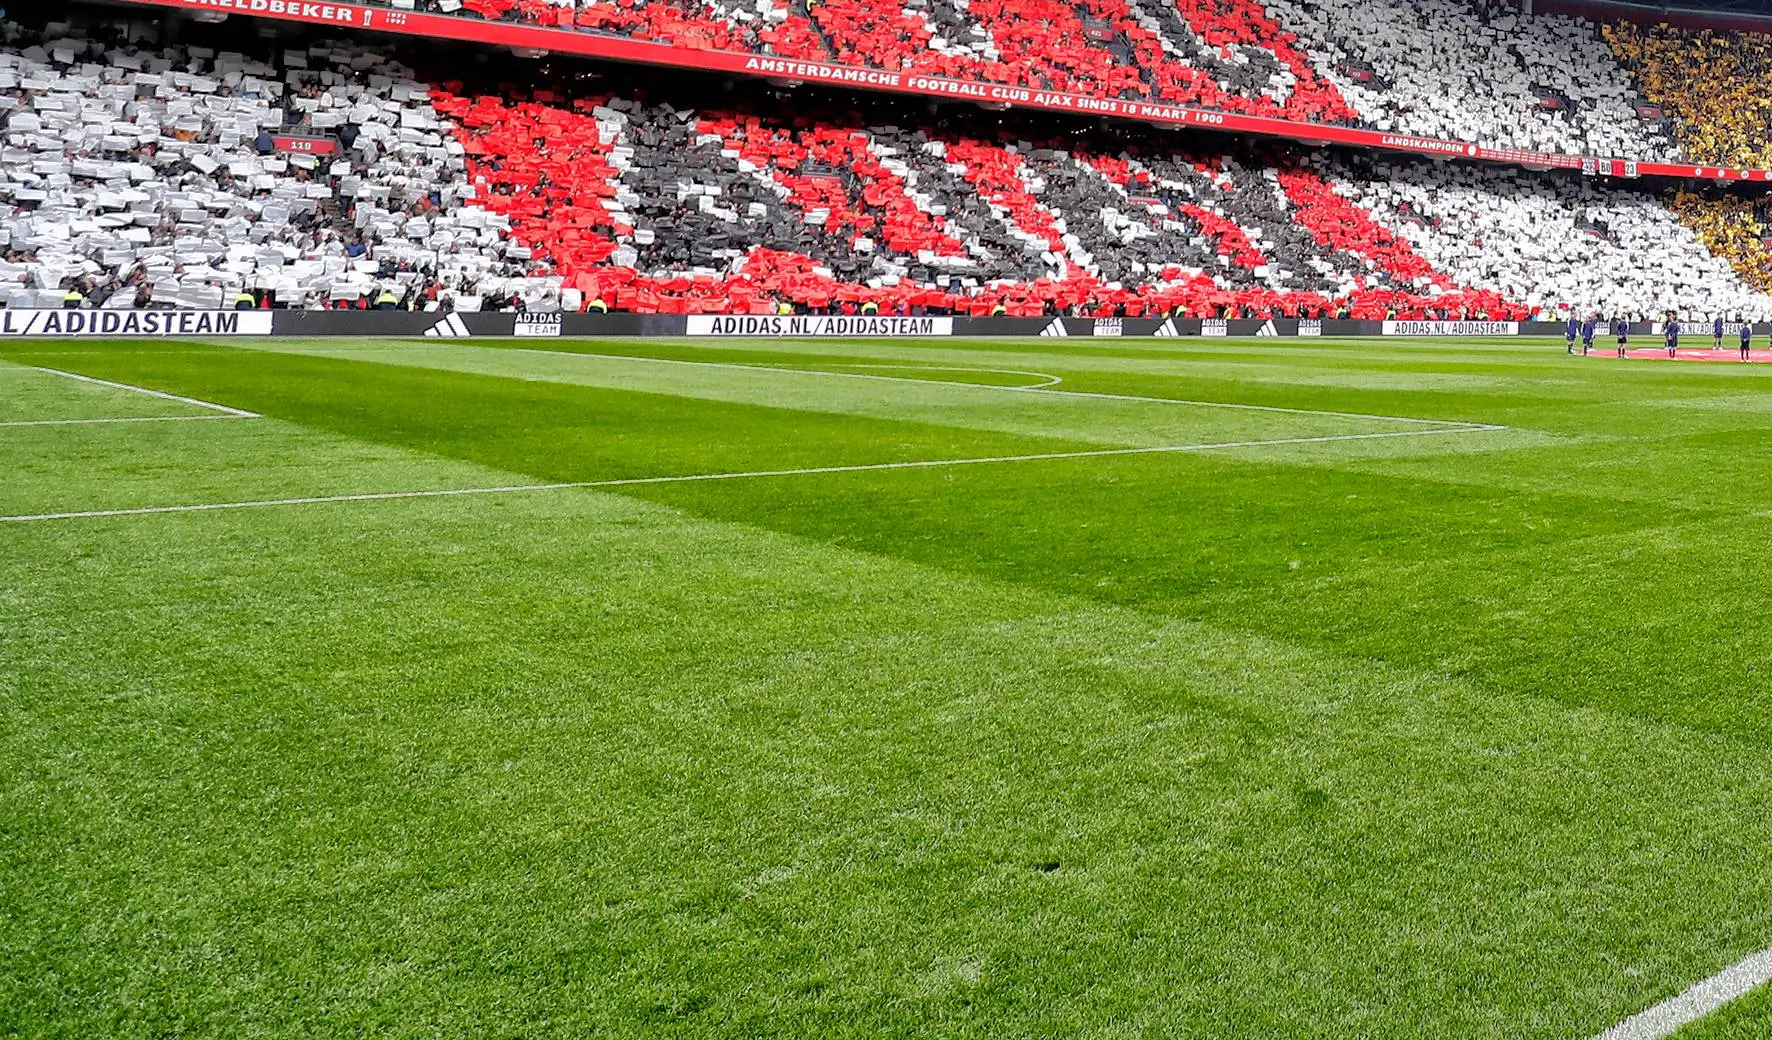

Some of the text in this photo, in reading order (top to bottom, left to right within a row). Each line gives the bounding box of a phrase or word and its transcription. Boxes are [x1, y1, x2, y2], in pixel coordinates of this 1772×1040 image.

[745, 58, 900, 86] AMSTERDAMSCHE
[907, 78, 987, 96] FOOTBALL
[991, 87, 1030, 101] CLUB
[1033, 93, 1073, 107] AJAX
[1077, 98, 1117, 112] SINDS
[1121, 103, 1136, 114] 18
[1141, 106, 1188, 120] MAART
[1194, 112, 1224, 124] 1900
[1381, 135, 1464, 153] LANDSKAMPIOEN
[515, 313, 562, 323] ADIDAS
[1094, 318, 1122, 326] ADIDAS
[1201, 319, 1227, 327] ADIDAS
[527, 325, 558, 334] TEAM
[711, 317, 933, 335] ADIDAS.NL/ADIDASTEAM
[1394, 322, 1509, 335] ADIDAS.NL/ADIDASTEAM
